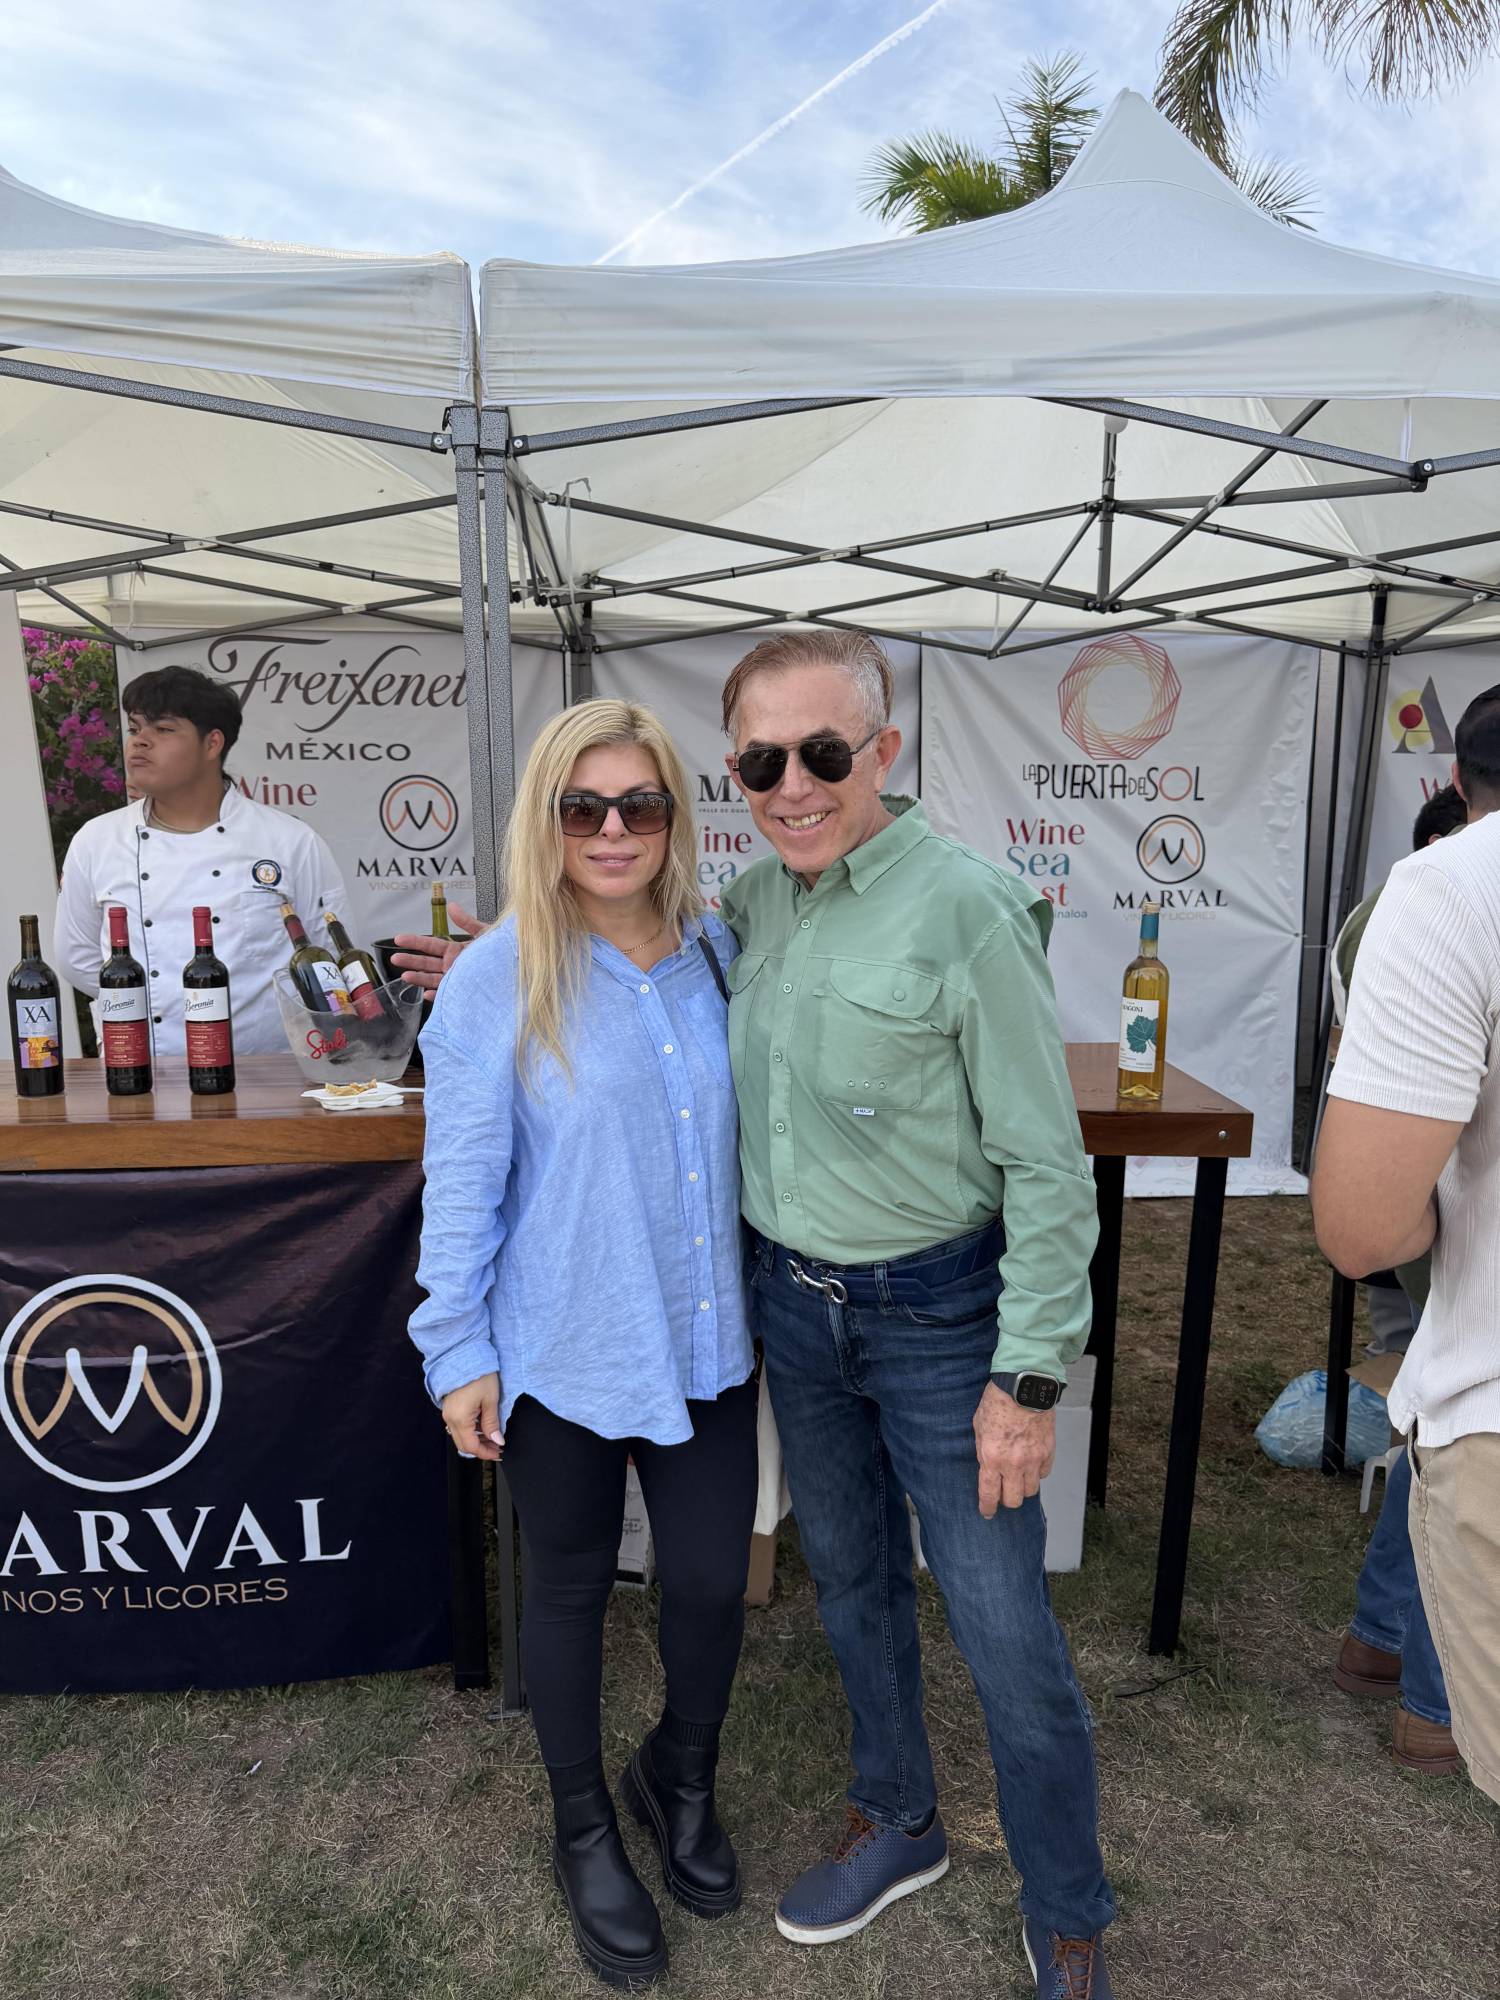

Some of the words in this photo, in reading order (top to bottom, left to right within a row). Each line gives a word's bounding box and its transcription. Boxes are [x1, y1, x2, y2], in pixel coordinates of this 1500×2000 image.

[208, 634, 468, 733] Freixenet
[266, 738, 411, 762] MÉXICO
[1022, 763, 1036, 782] LA
[1035, 764, 1127, 800] PUERTA
[1127, 776, 1148, 796] DEL
[1145, 765, 1204, 801] SOL
[700, 825, 752, 854] ine
[1006, 818, 1085, 846] Wine
[356, 856, 477, 878] MARVA
[697, 860, 736, 885] ea
[1007, 846, 1070, 877] Sea
[1113, 888, 1228, 909] MARVAL
[23, 1005, 51, 1024] XA
[0, 1498, 352, 1577] ARVAL
[2, 1588, 84, 1613] NOS
[92, 1586, 114, 1610] Y
[124, 1578, 289, 1610] LICORES
